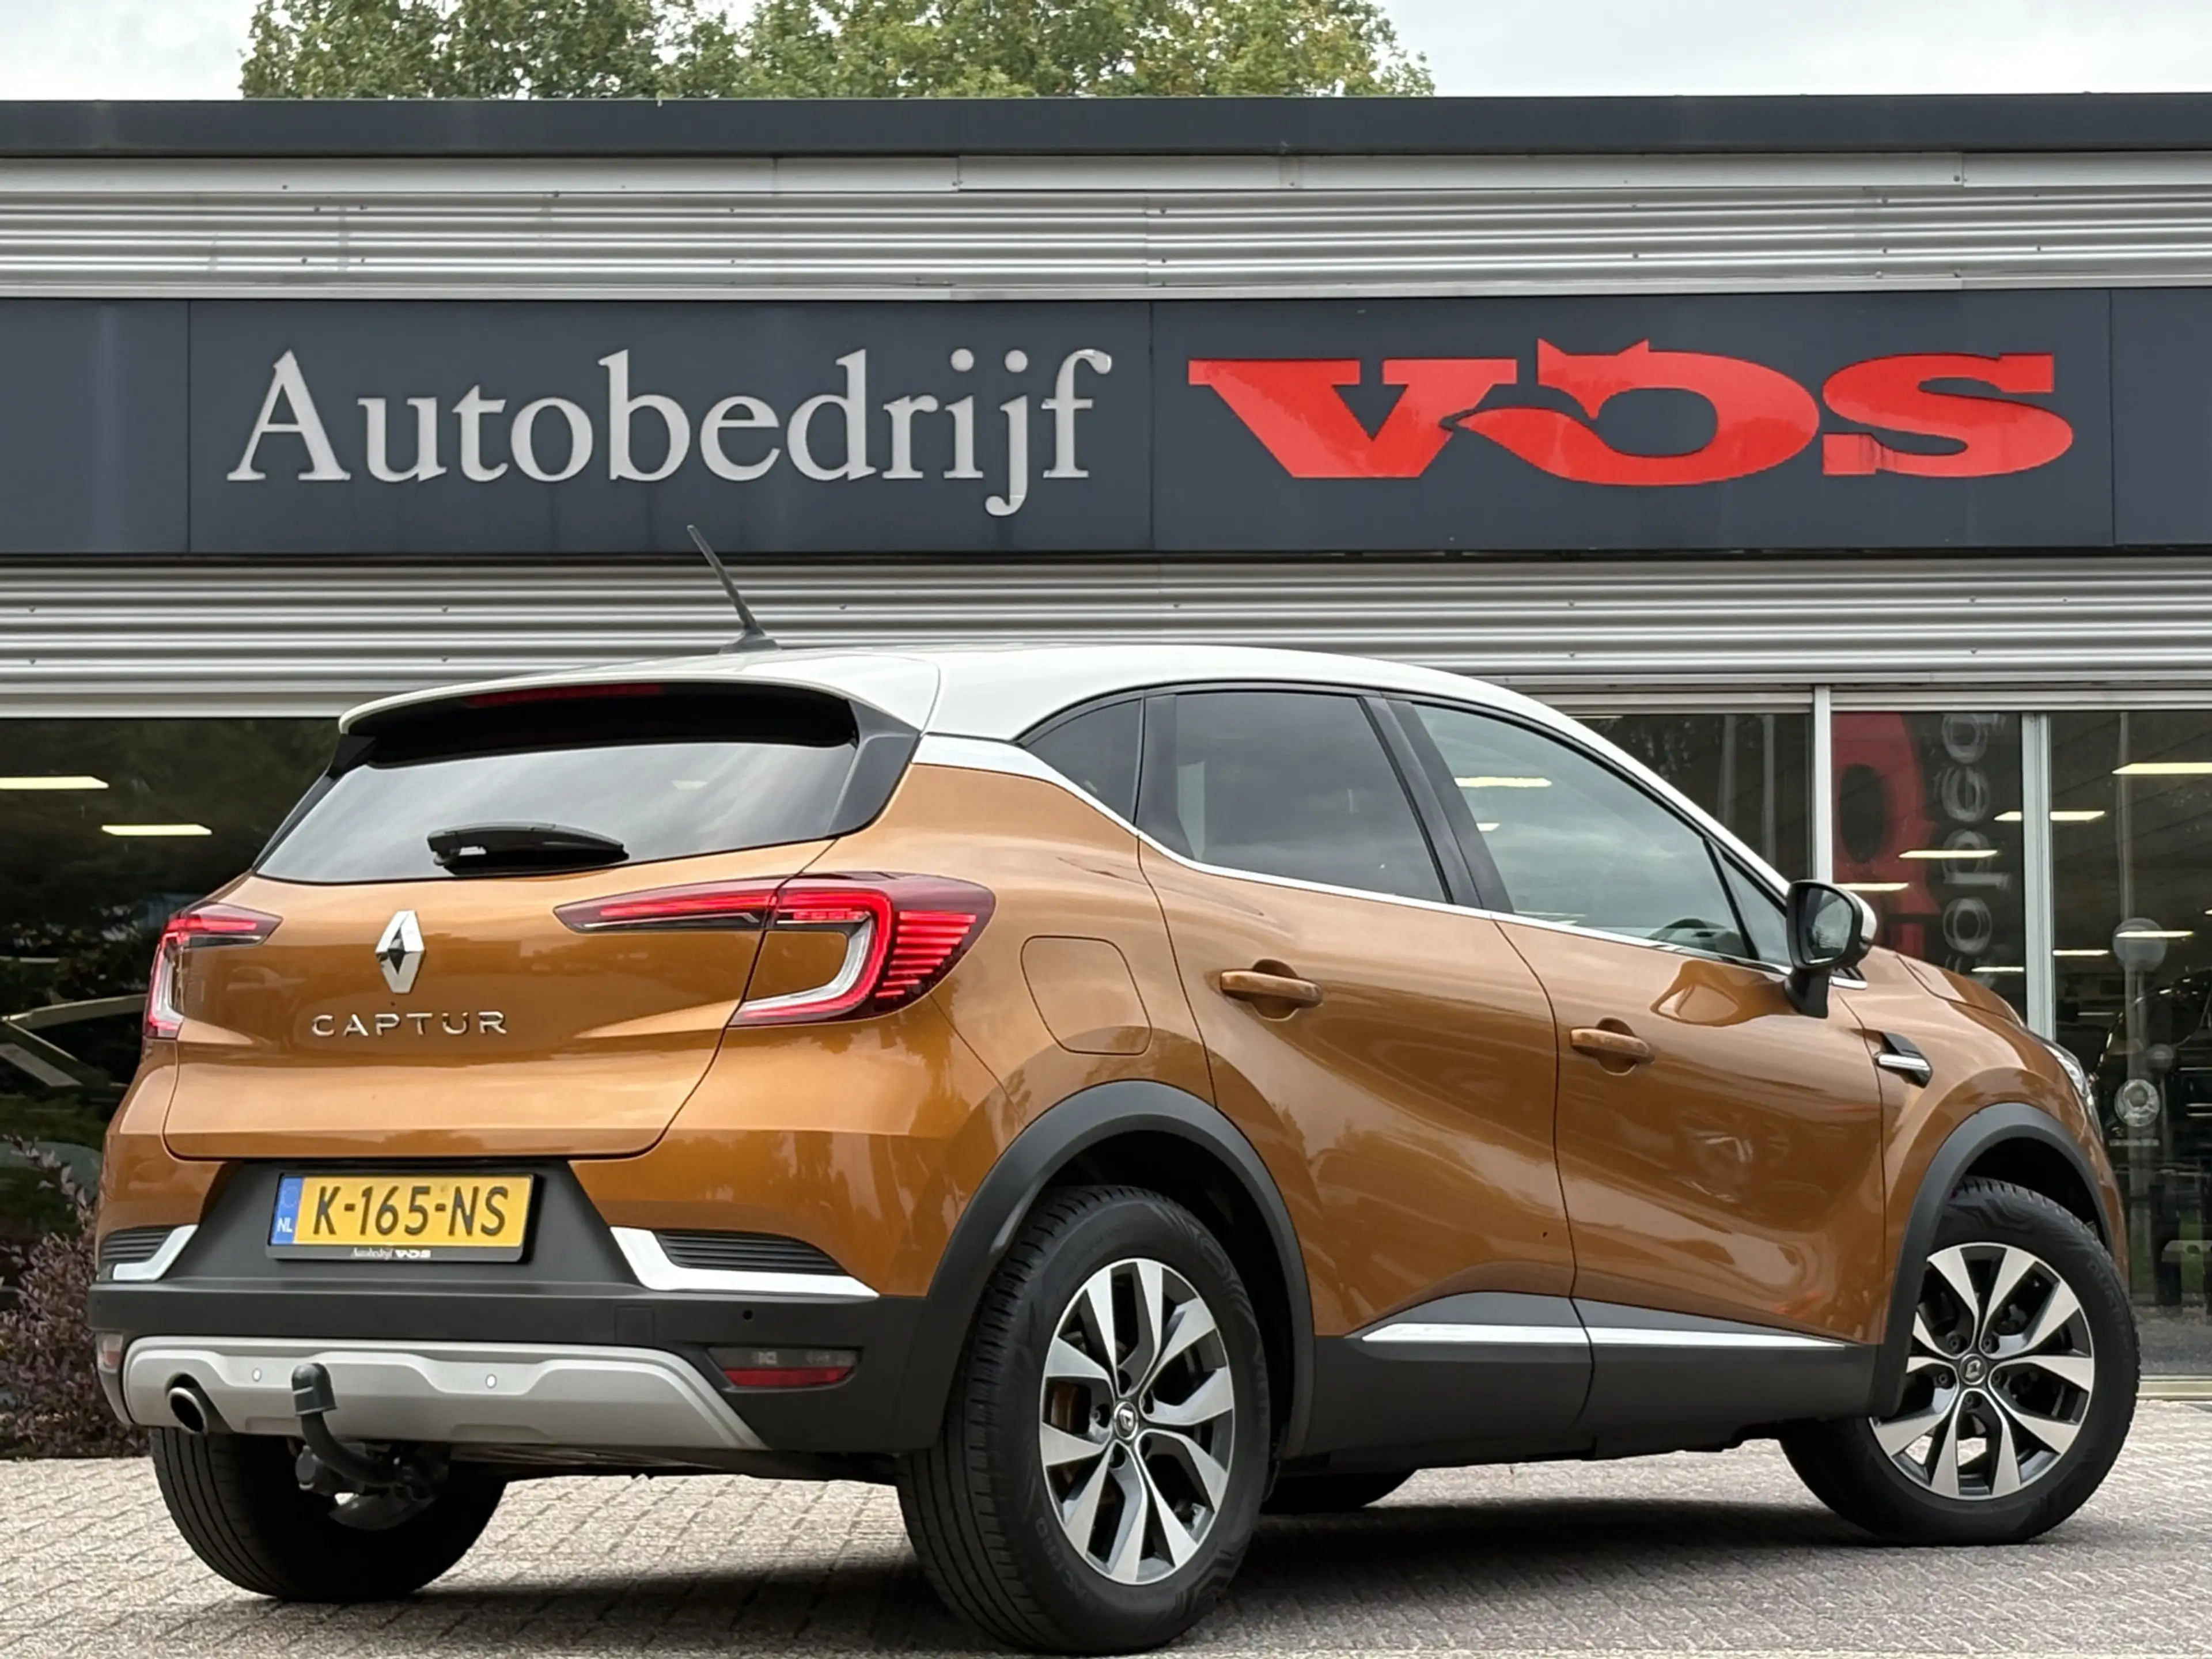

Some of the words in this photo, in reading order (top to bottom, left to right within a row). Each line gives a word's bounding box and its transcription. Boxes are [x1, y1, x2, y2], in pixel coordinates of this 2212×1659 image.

[227, 348, 1112, 517] Autobedrijf
[1188, 338, 2074, 486] VOS
[311, 1010, 508, 1037] CAPTUR
[277, 1217, 293, 1233] NL
[312, 1185, 509, 1237] K-165-NS
